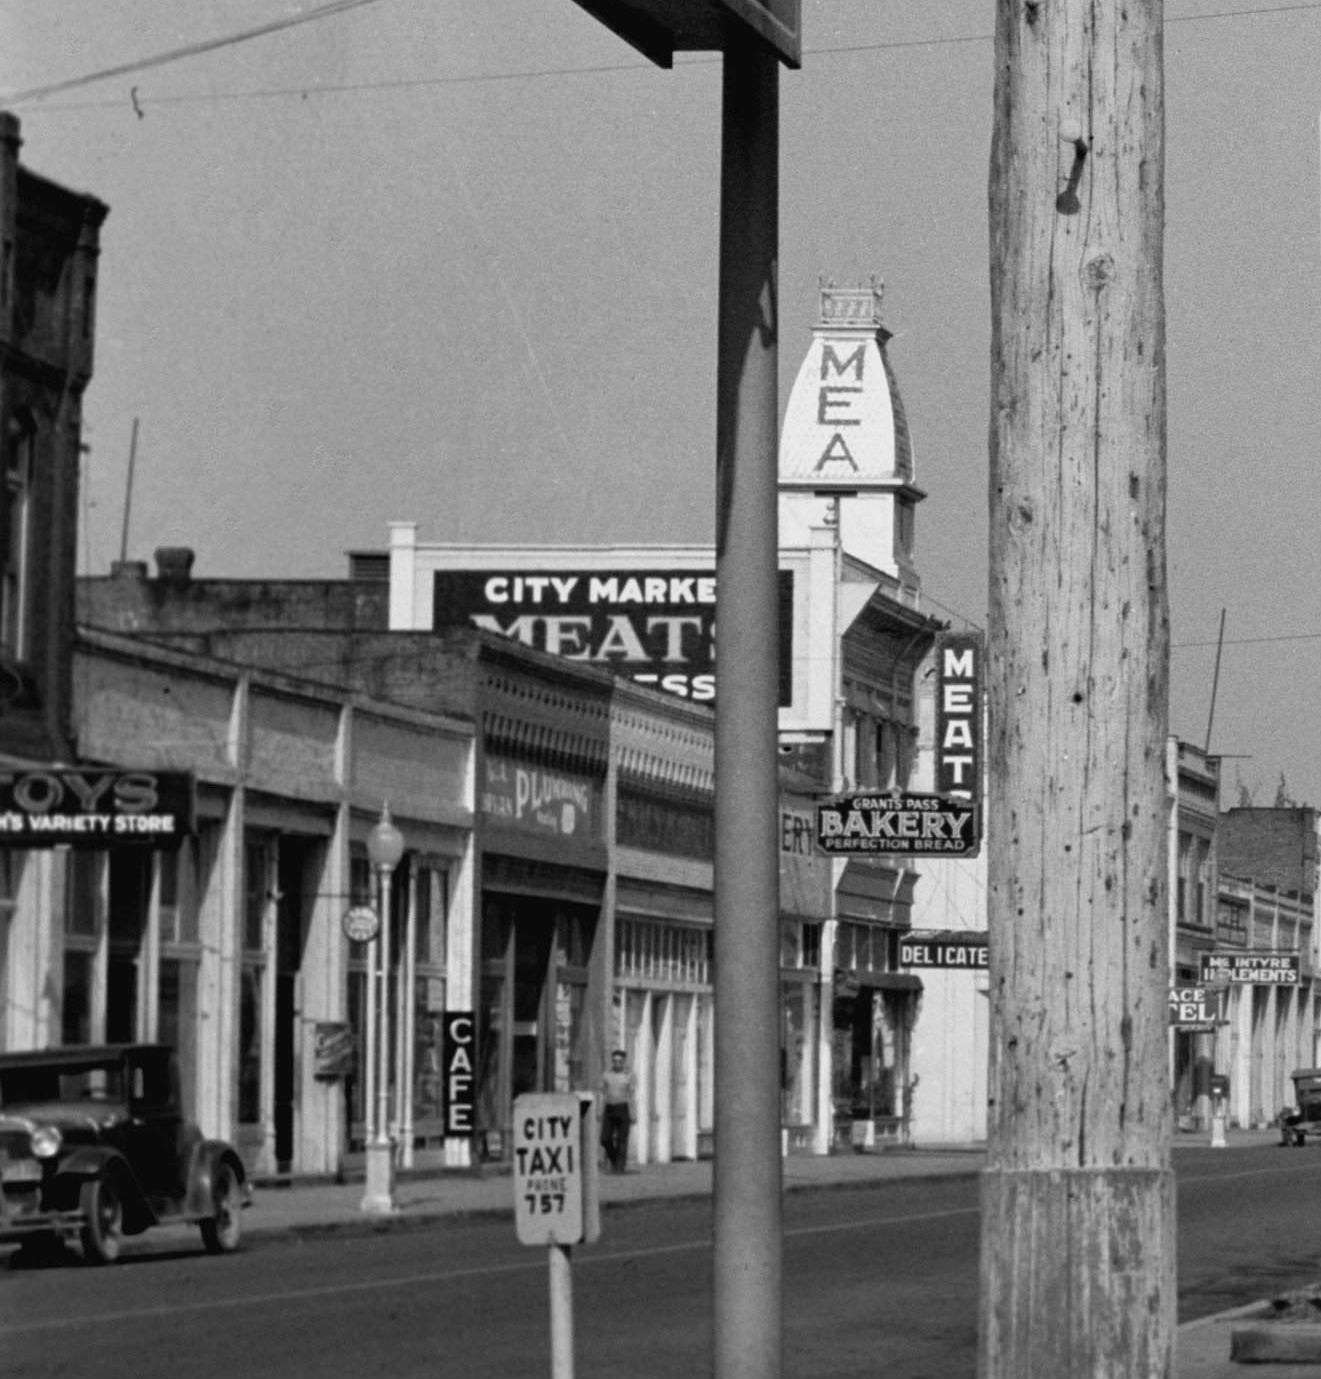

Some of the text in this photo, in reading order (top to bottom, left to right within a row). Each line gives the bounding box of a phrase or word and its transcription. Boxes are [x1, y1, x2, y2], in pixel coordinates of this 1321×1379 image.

[484, 576, 717, 604] CITY MARKE
[470, 614, 717, 663] MEAT
[943, 649, 974, 800] MEAT
[853, 798, 939, 811] GRANTS PASS
[29, 814, 110, 832] VARIETY
[114, 814, 175, 833] STORE
[820, 810, 971, 838] BAKERY
[826, 838, 965, 850] PERFECTION BREAD
[902, 945, 988, 965] DELICATE
[1235, 957, 1291, 969] INTYRE
[450, 1018, 472, 1131] CAFE
[524, 1116, 572, 1140] CITY
[516, 1145, 574, 1176] TAXI
[527, 1177, 567, 1193] PHONE
[525, 1193, 565, 1215] 757
